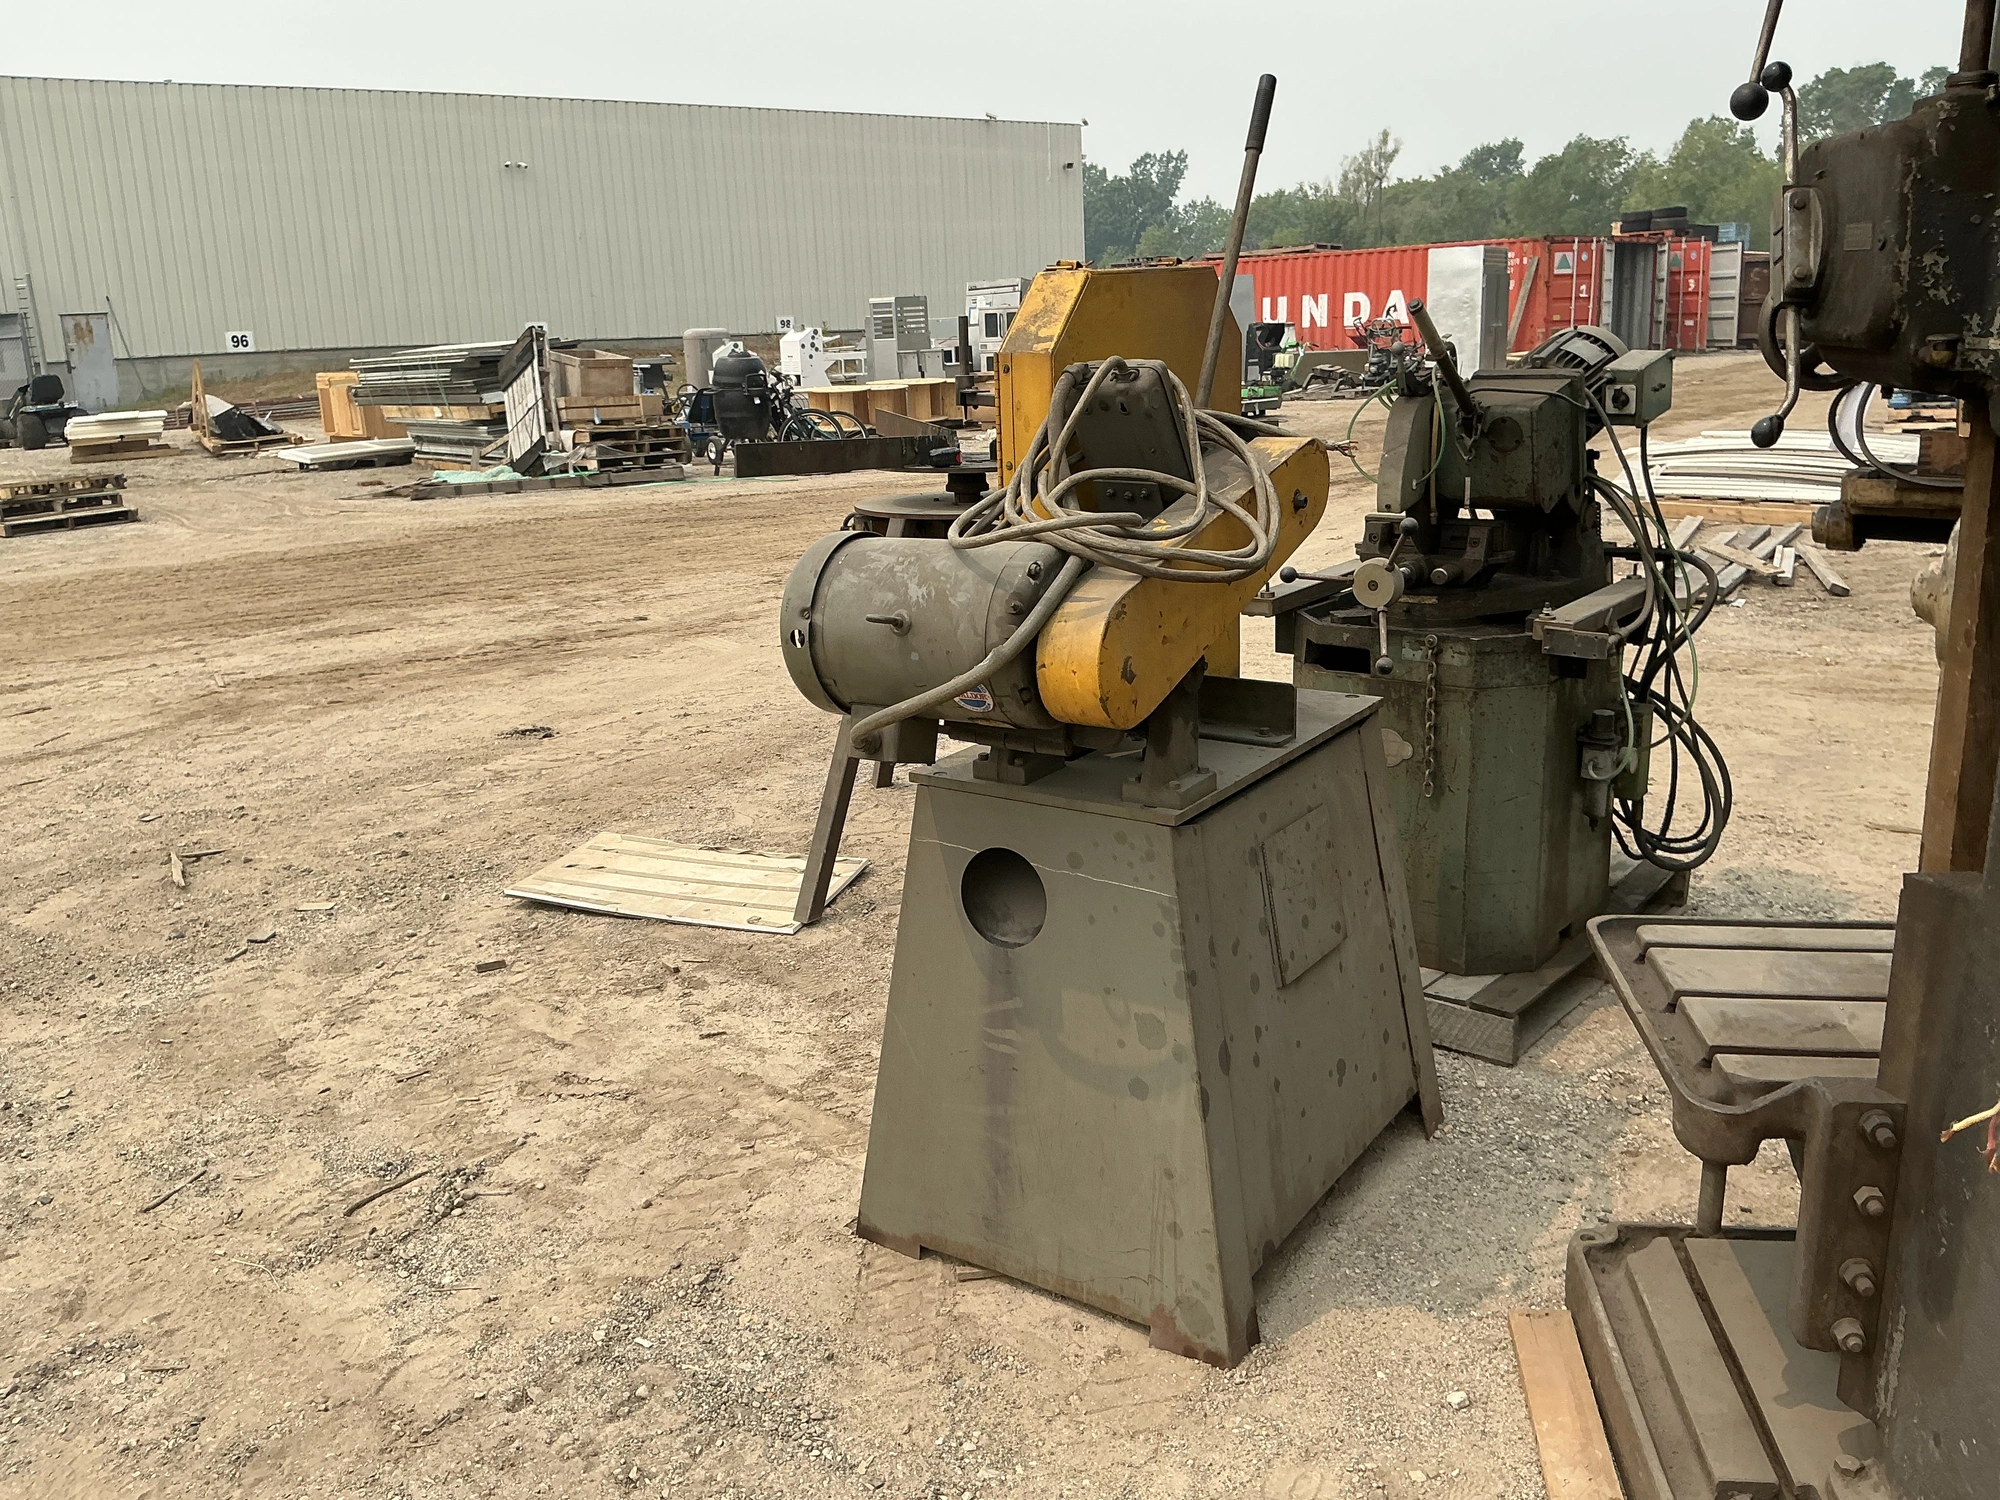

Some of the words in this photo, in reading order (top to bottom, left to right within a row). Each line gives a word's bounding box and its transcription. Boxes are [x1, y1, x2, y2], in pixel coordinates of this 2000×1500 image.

[1579, 284, 1588, 298] 1
[780, 319, 791, 328] 98
[231, 334, 249, 348] 96
[959, 691, 990, 701] ALDOR
